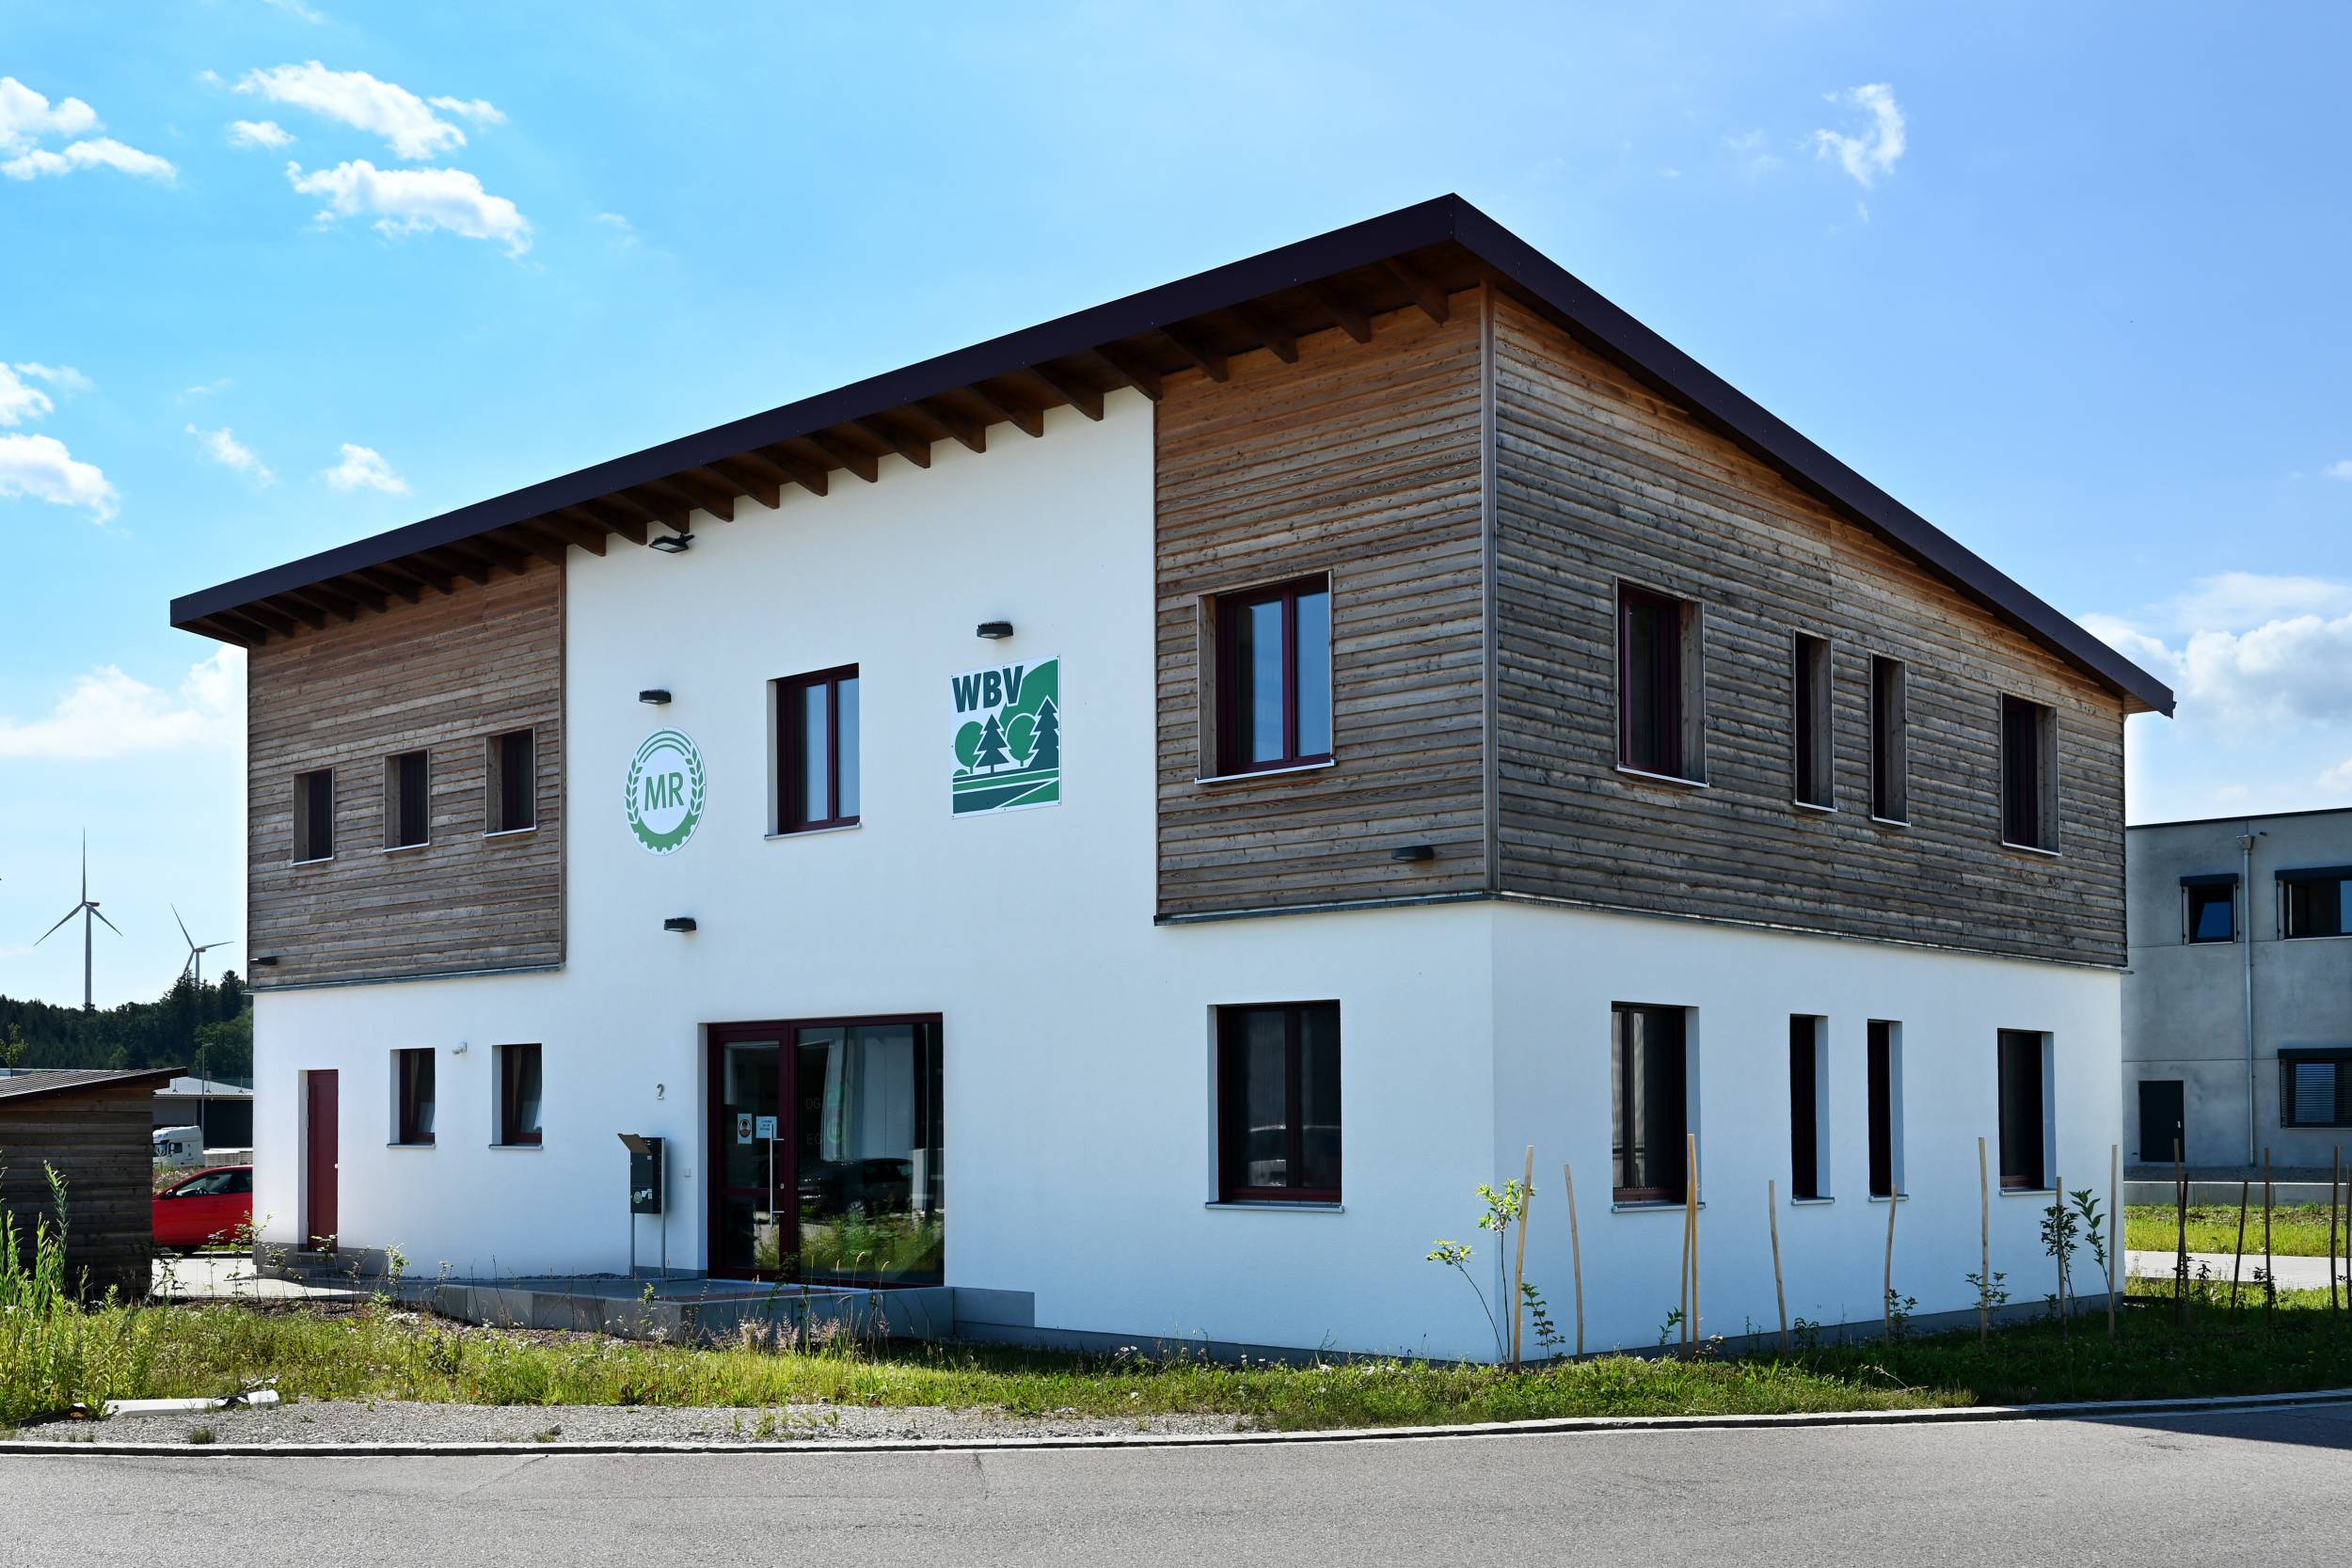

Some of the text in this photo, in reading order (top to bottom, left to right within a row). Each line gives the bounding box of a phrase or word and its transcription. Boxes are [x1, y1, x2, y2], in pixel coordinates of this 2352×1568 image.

[951, 665, 1025, 714] WBV
[644, 771, 685, 812] MR
[657, 1084, 664, 1101] 2
